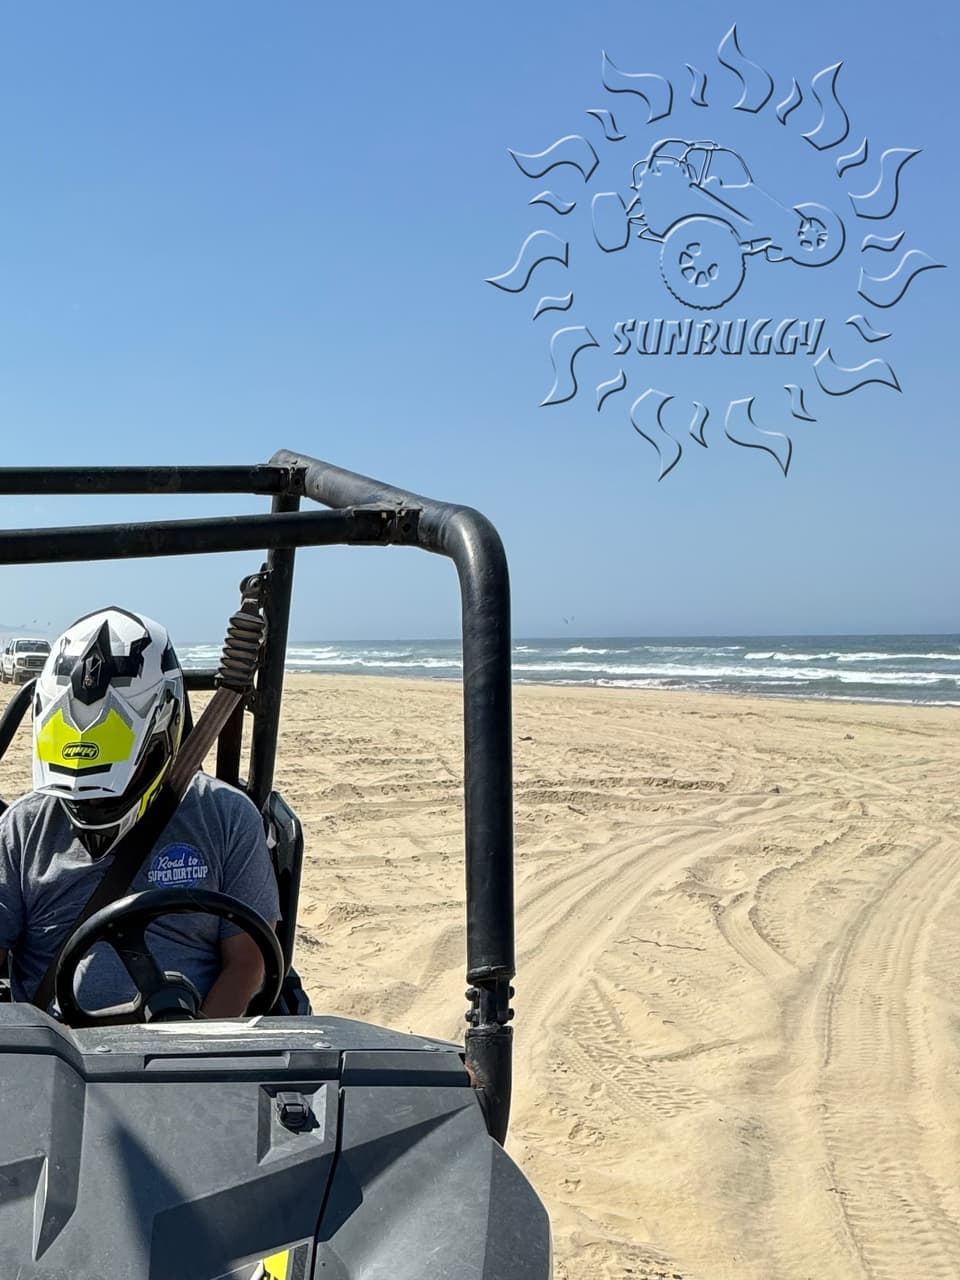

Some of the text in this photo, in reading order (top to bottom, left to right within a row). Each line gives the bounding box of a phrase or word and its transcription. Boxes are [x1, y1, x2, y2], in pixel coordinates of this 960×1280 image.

[157, 853, 199, 869] Road to
[148, 868, 172, 882] SUPER
[193, 865, 208, 878] CUP
